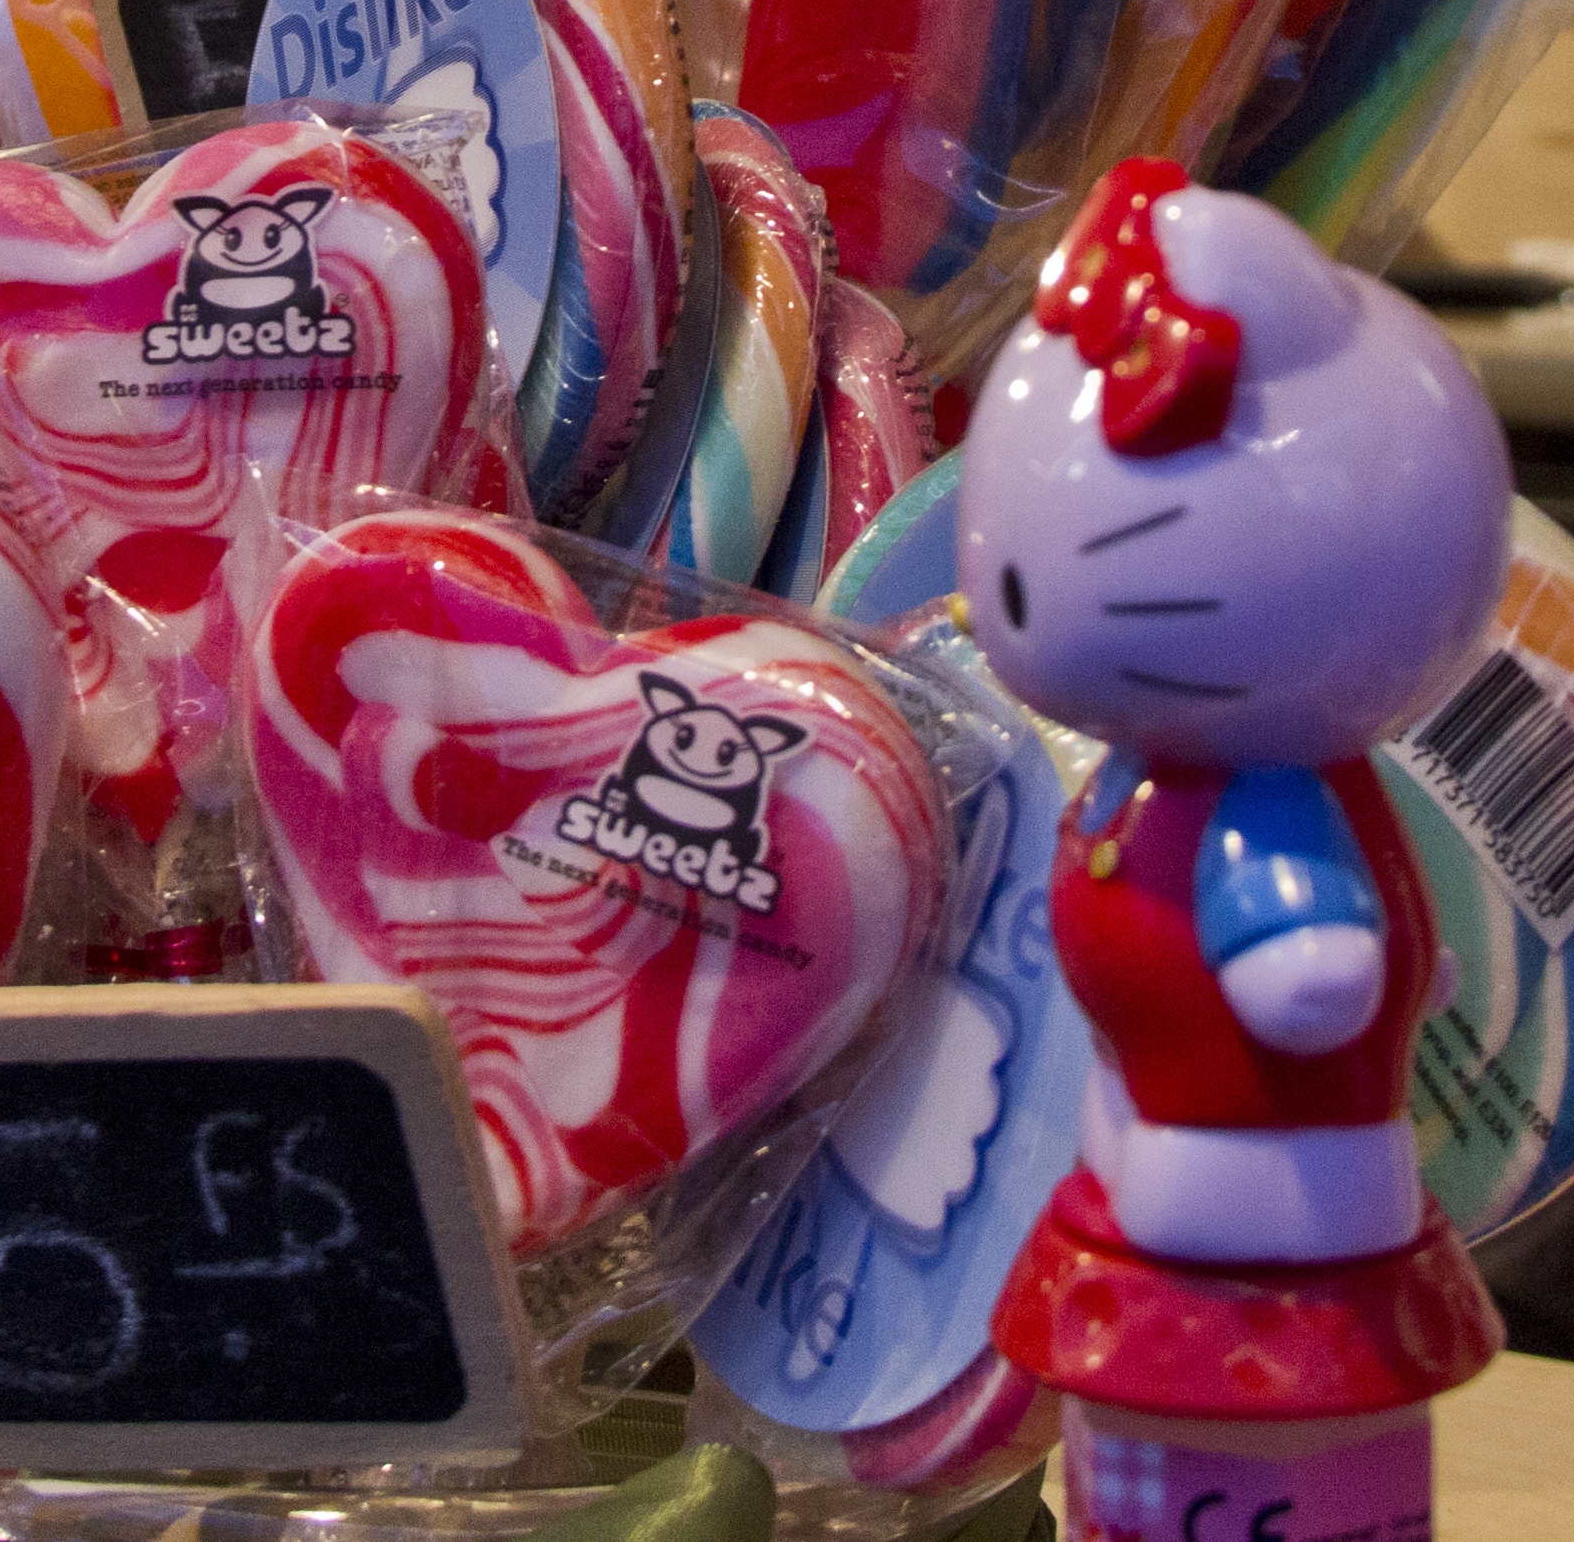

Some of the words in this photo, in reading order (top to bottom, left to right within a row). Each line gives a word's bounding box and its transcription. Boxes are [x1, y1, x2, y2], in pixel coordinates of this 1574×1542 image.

[143, 305, 356, 363] sweetz
[99, 379, 140, 399] The
[146, 376, 194, 397] next
[200, 370, 326, 397] generation
[331, 369, 403, 393] candy
[557, 797, 780, 915] sweetz
[503, 835, 541, 867] The
[738, 931, 814, 970] candy
